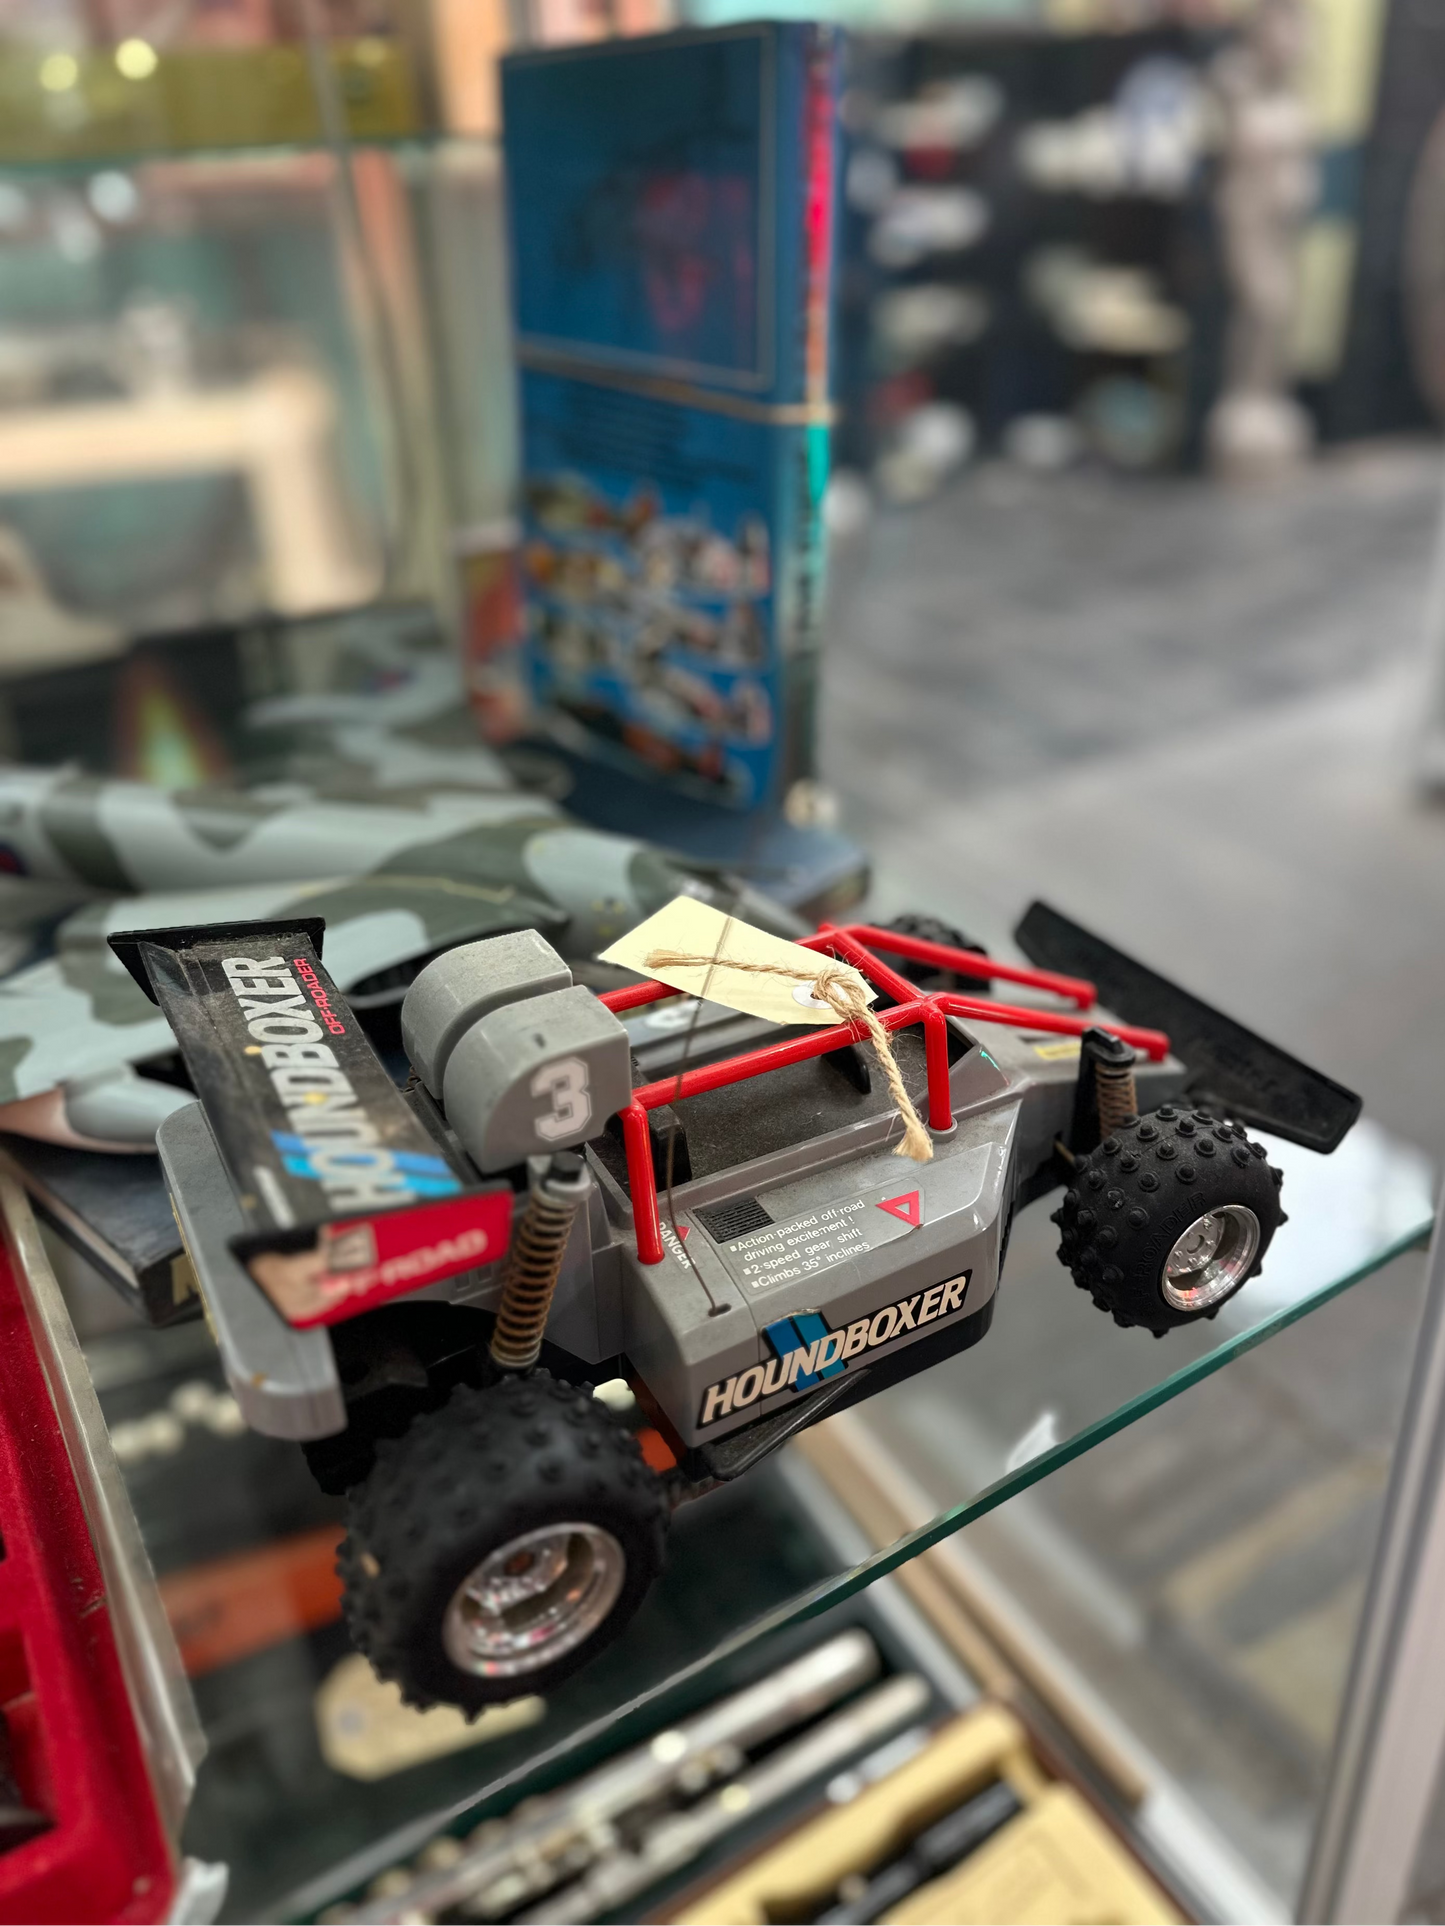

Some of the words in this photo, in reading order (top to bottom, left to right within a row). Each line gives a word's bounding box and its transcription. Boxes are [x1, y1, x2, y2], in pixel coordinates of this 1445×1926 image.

[292, 957, 346, 1035] OFF-ROADER
[222, 956, 416, 1211] HOUNDBOXER
[530, 1056, 592, 1142] 3
[658, 1221, 696, 1270] DANGER
[737, 1215, 819, 1251] Action-packed
[820, 1199, 866, 1221] off-road
[743, 1242, 786, 1263] driving
[786, 1217, 848, 1247] excitement
[750, 1249, 802, 1275] 2-speed
[804, 1239, 832, 1256] gear
[836, 1227, 863, 1244] shift
[757, 1265, 801, 1287] Climbs
[801, 1256, 821, 1271] 35°
[824, 1241, 870, 1263] inclines
[702, 1275, 967, 1424] HOUNDBOXER
